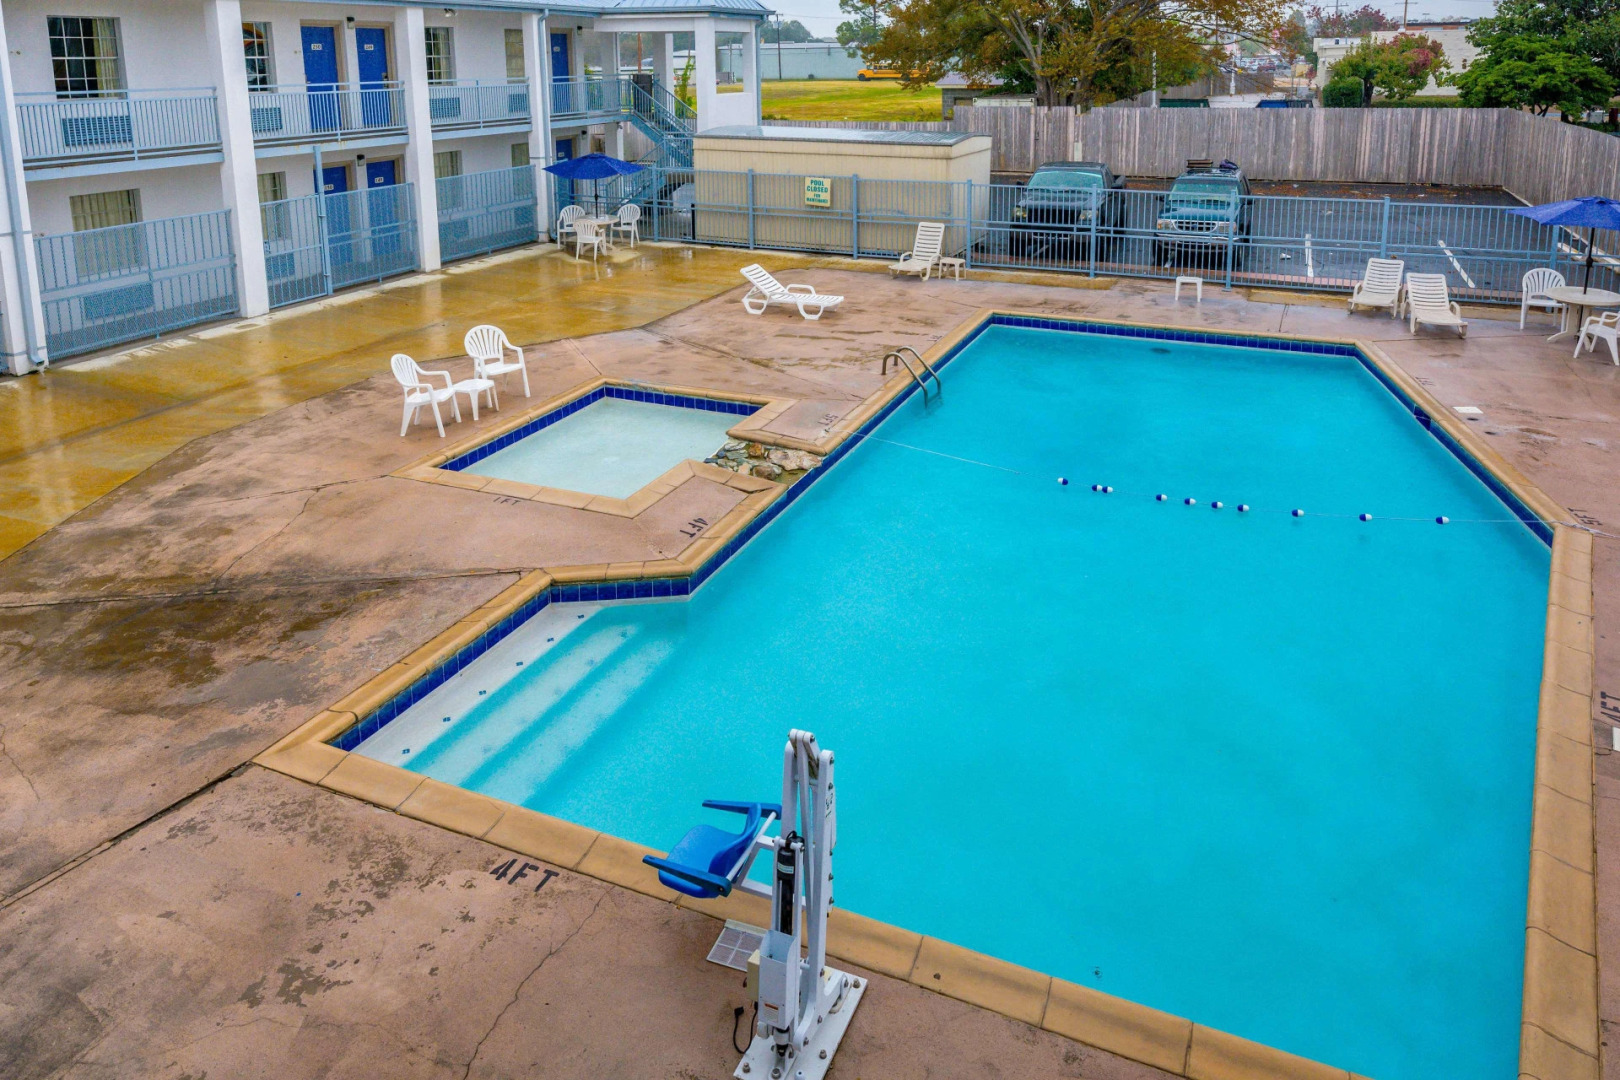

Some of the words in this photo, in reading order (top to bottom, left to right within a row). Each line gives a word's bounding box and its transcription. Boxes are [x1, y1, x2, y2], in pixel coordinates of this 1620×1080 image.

[806, 185, 829, 193] CLOSED
[810, 179, 825, 187] POOL
[679, 517, 709, 538] 4FT
[489, 858, 560, 893] 4FT
